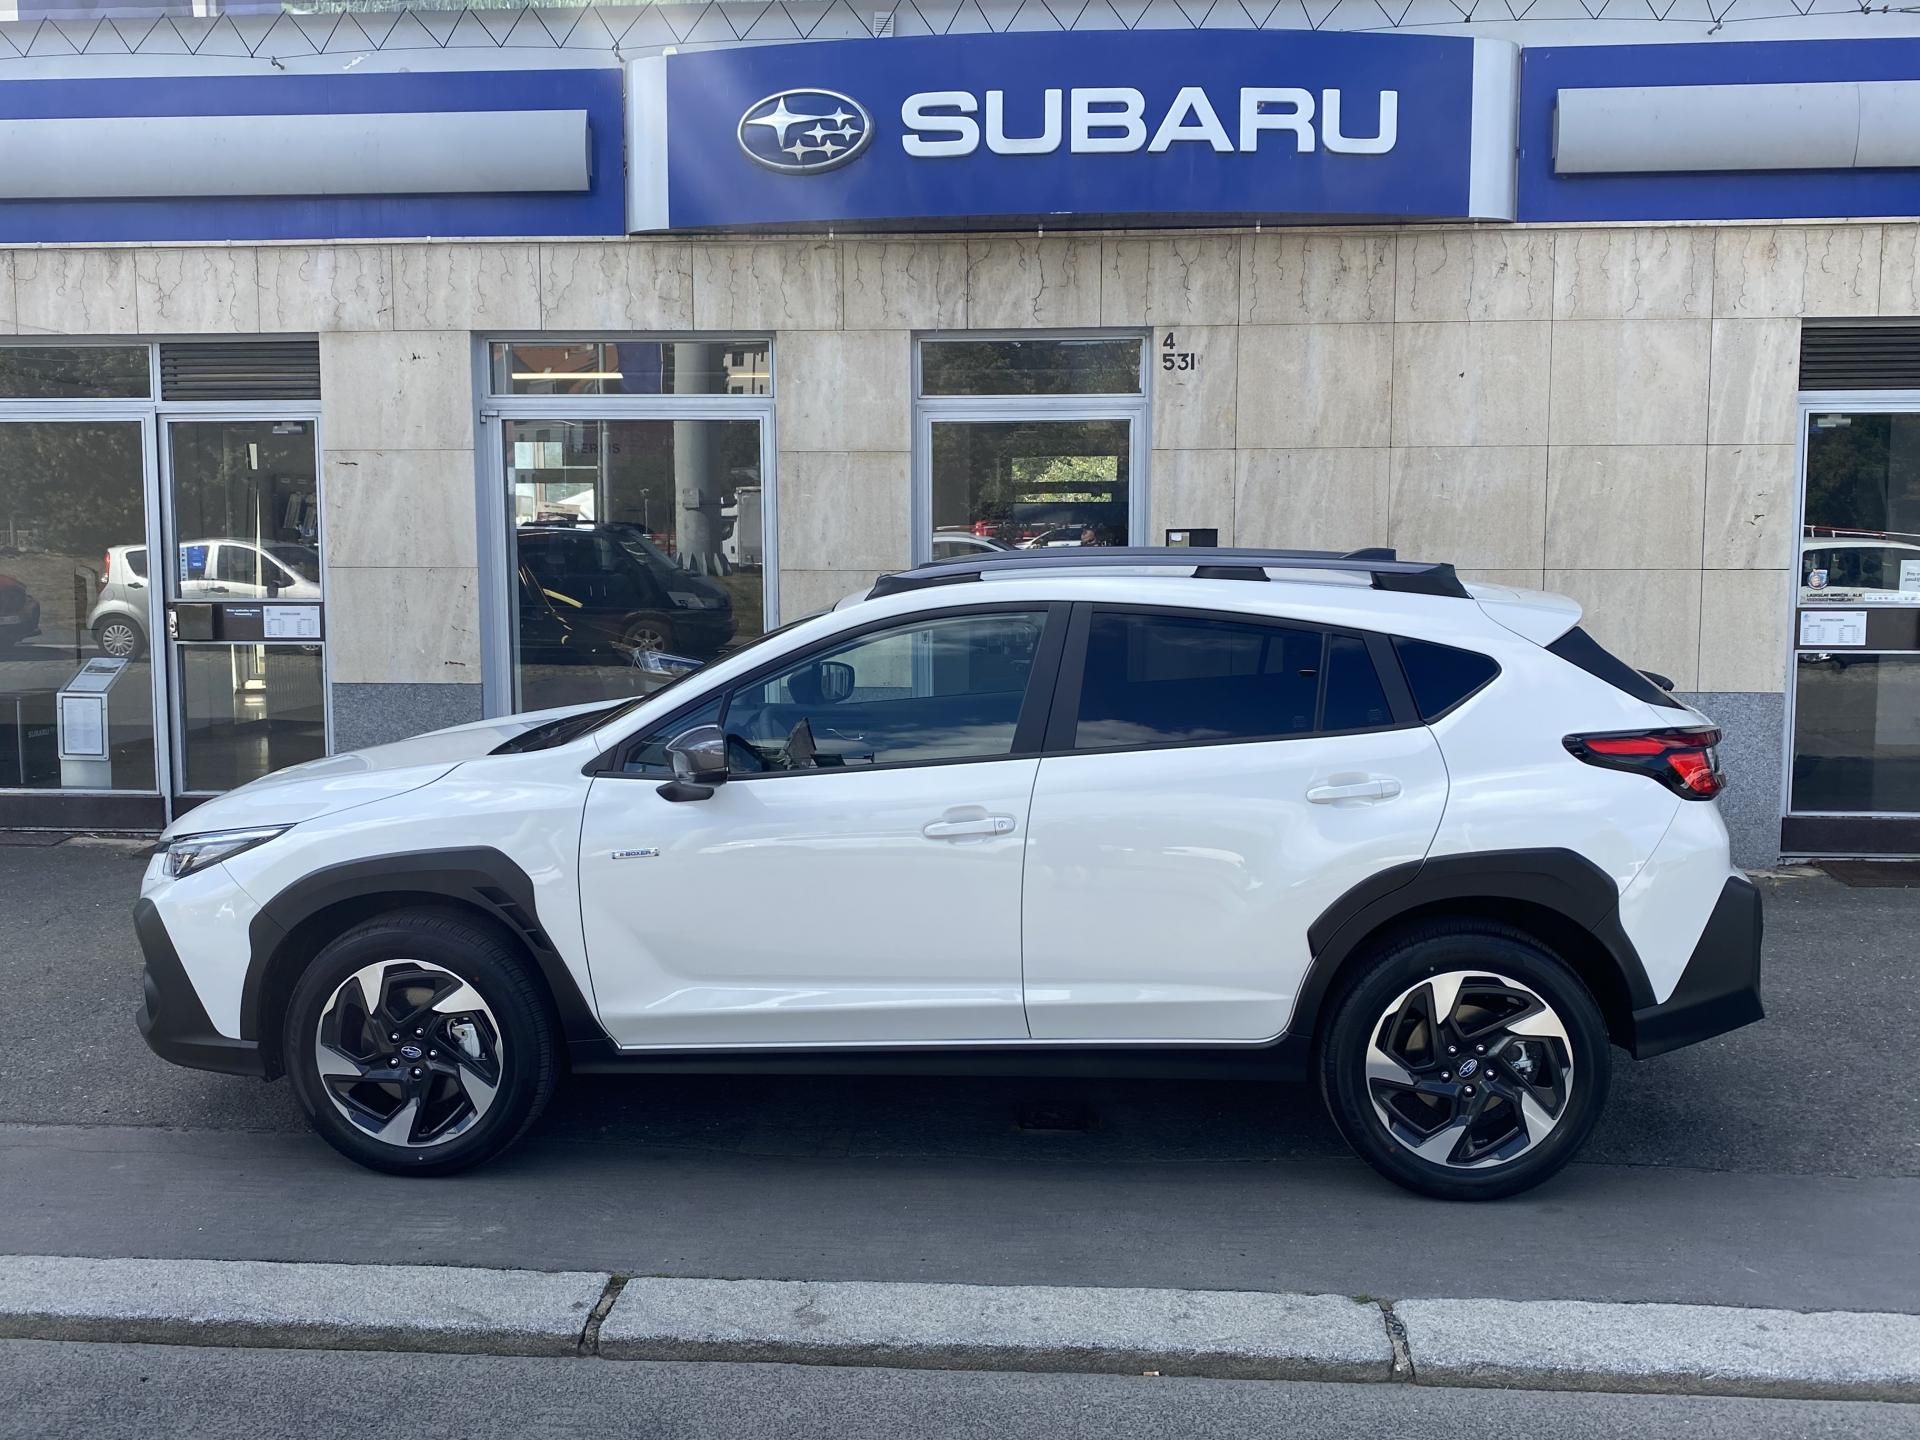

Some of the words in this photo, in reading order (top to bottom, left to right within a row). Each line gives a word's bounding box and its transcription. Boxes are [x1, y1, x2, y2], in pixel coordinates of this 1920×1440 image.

[901, 87, 1398, 156] SUBARU
[1162, 332, 1176, 350] 4
[1162, 353, 1195, 371] 531
[571, 442, 621, 454] SERIS
